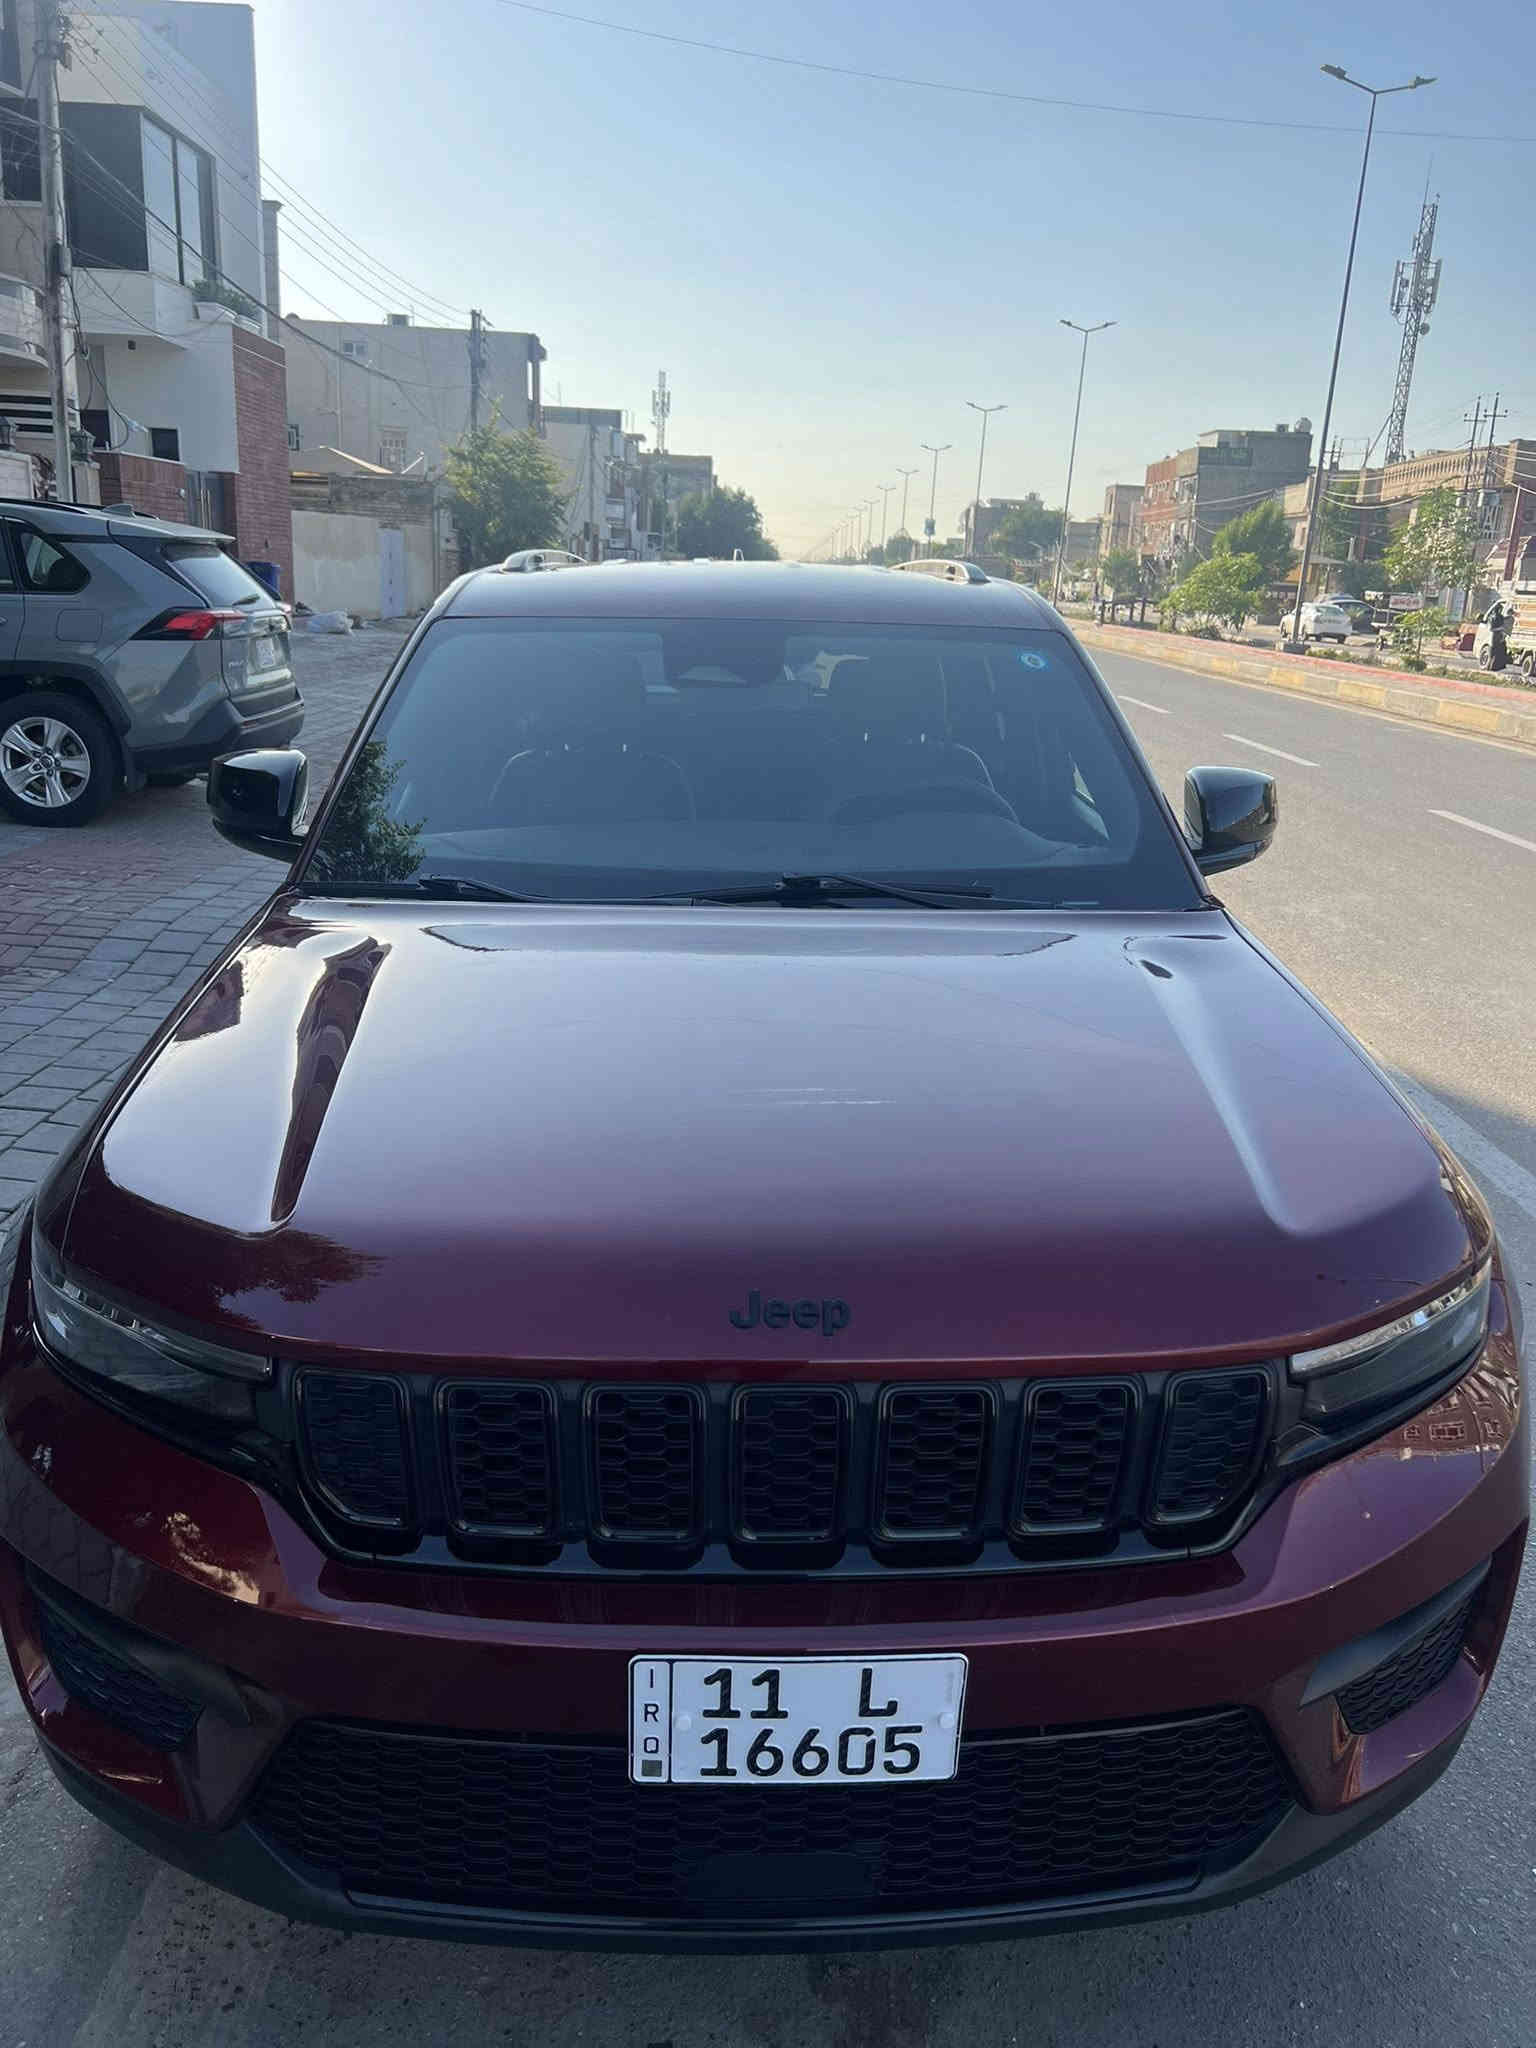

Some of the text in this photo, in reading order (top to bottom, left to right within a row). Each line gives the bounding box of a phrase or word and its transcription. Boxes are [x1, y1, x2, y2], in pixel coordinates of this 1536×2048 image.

[728, 1290, 851, 1337] Jeep
[702, 1668, 899, 1719] 11 L
[700, 1724, 923, 1777] 16605
